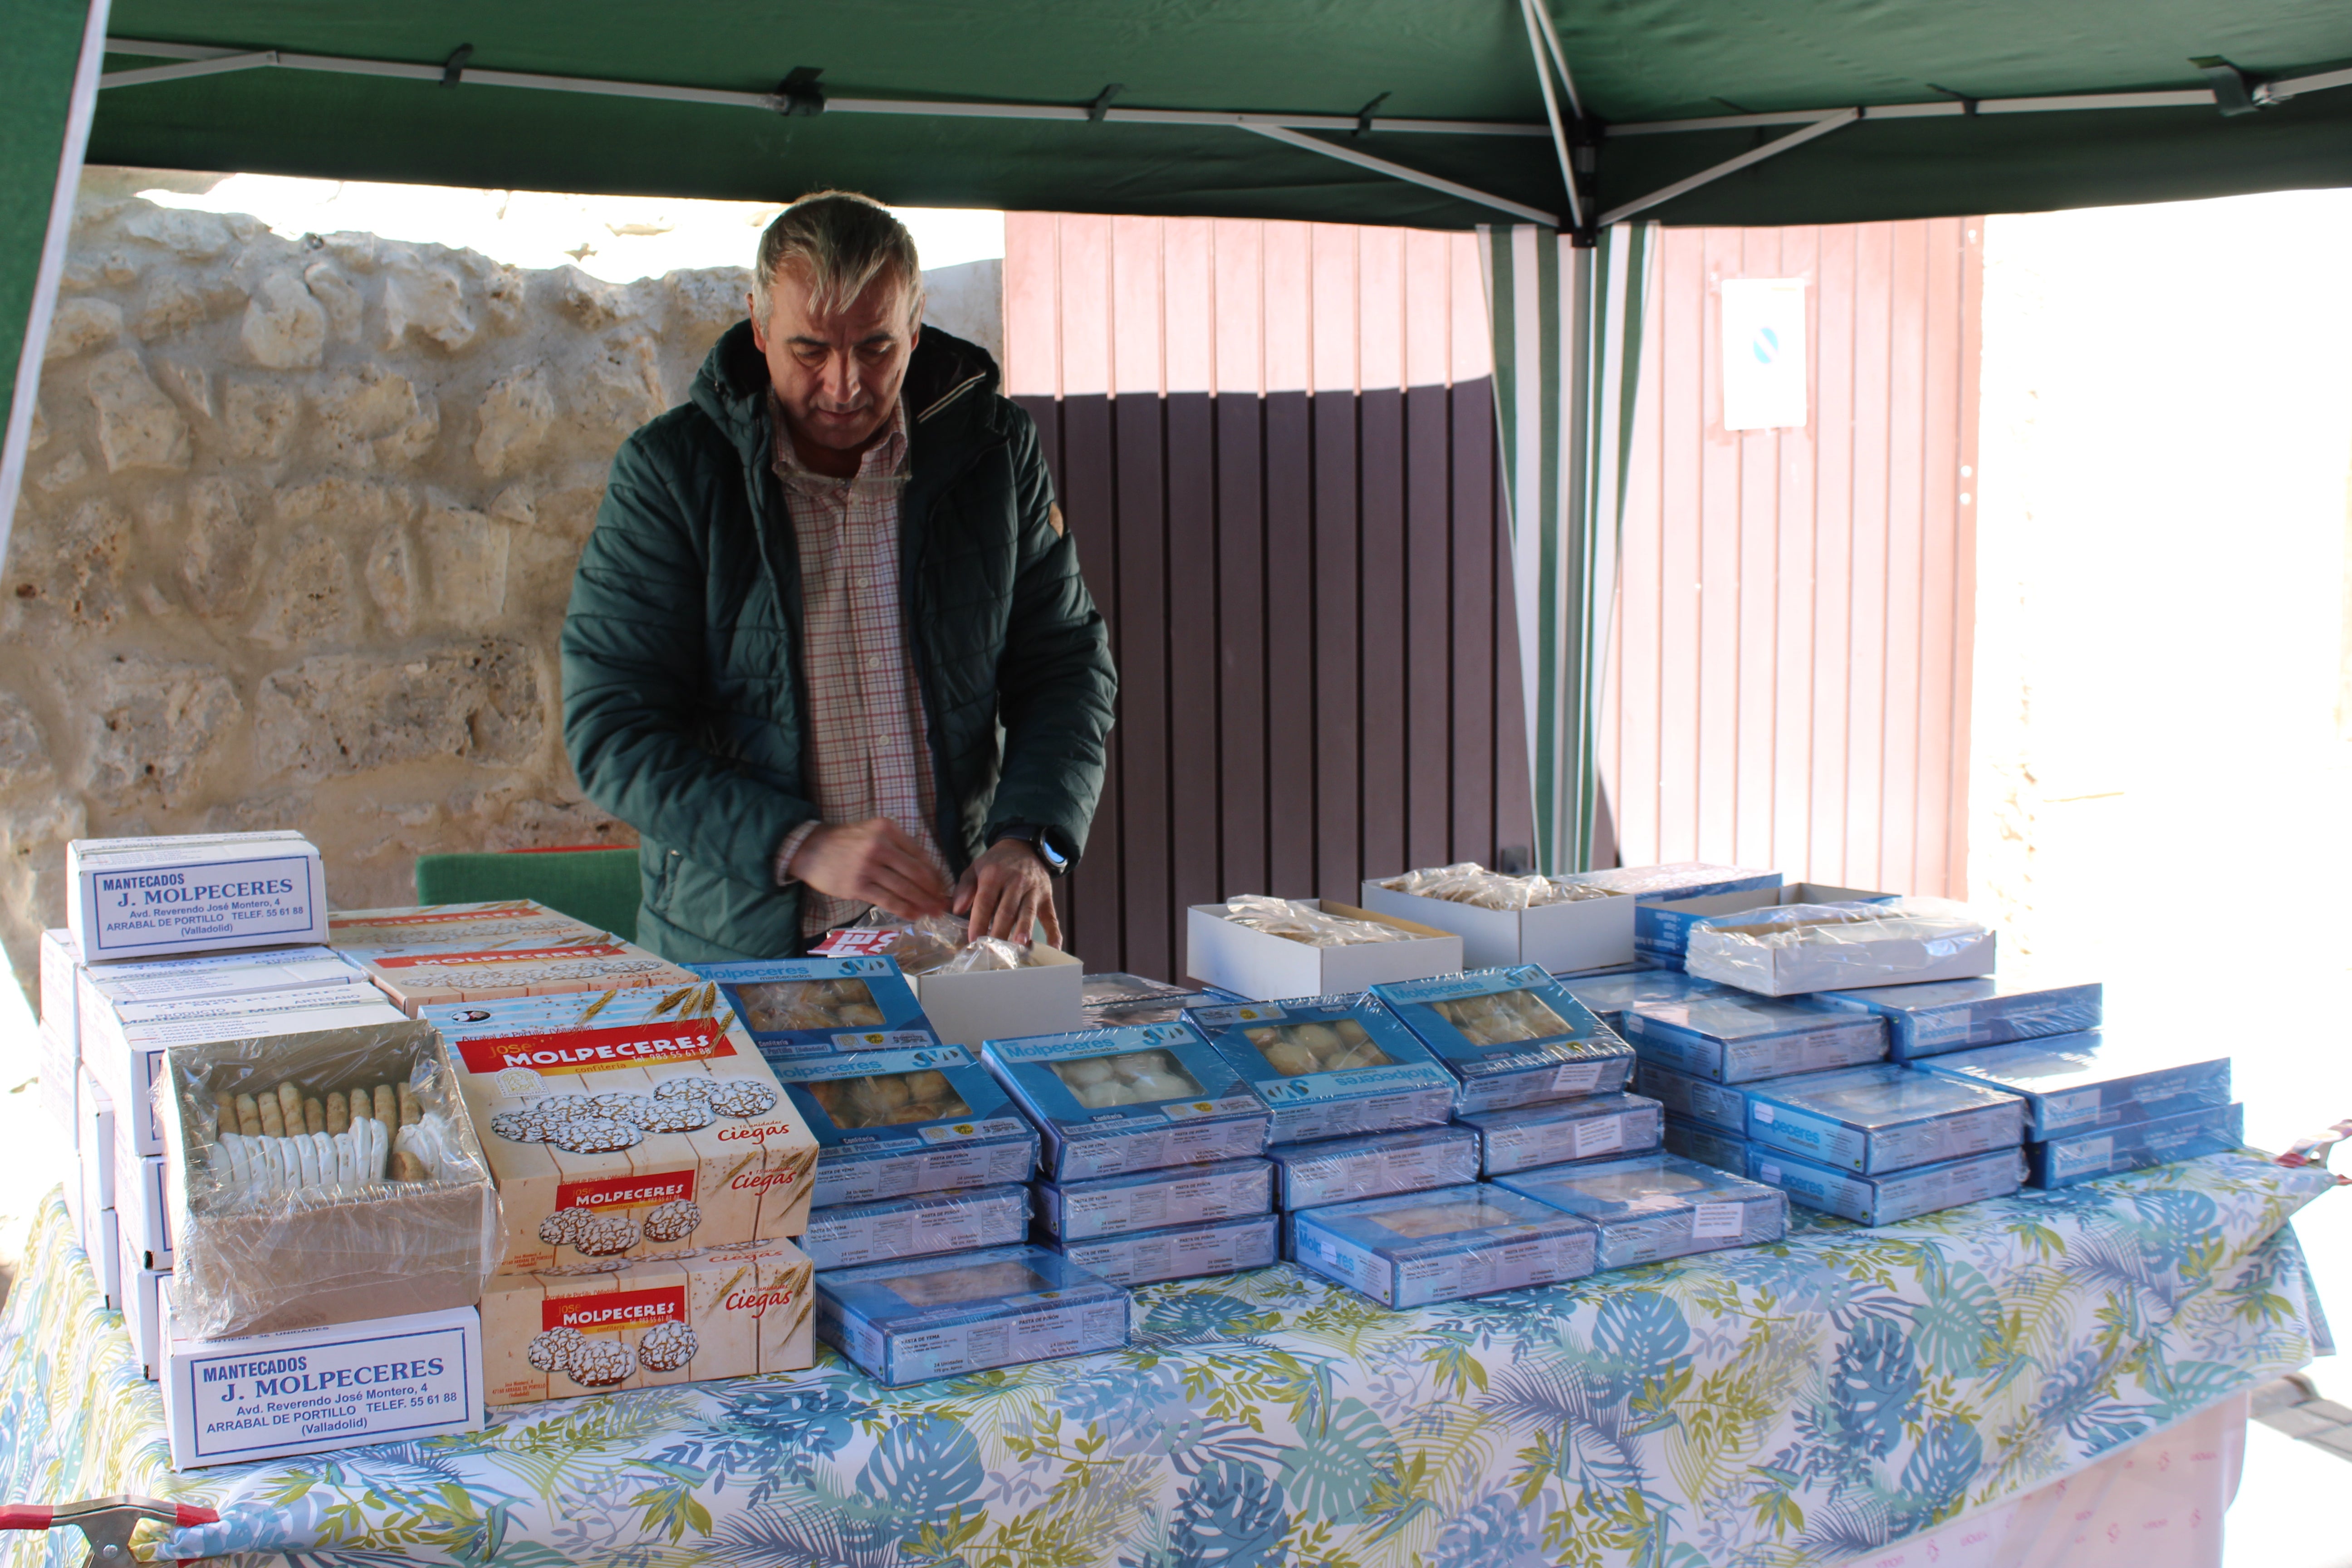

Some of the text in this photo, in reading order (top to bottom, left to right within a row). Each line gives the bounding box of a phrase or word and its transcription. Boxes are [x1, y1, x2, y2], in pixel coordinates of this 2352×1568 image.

[103, 873, 185, 891] MANTECADOS
[118, 878, 293, 907] J. MOLPECERES
[129, 909, 151, 918] Avd.
[154, 904, 204, 917] Reverendo
[206, 902, 229, 912] José
[231, 899, 272, 910] Montero,
[107, 906, 304, 931] ARRABAL DE PORTILLO TELEF. 55 61 88
[350, 911, 522, 928] MOLPECERES
[181, 923, 233, 937] (Valladolid)
[414, 948, 603, 966] MOLPECERES
[697, 965, 809, 980] Molpeceres
[1391, 980, 1484, 1000] Molpeceres
[122, 1000, 360, 1025] Mantecados Molpeceres
[155, 994, 360, 1019] PRODUCTO ARTESANO
[462, 1033, 496, 1042] Arrabal
[512, 1029, 545, 1038] Portillo
[549, 1025, 593, 1035] (Valladolid)
[503, 1034, 711, 1068] MOLPECERES
[767, 1046, 793, 1054] Portillo
[1004, 1038, 1115, 1058] Molpeceres
[1069, 1046, 1120, 1057] mantecados
[575, 1048, 712, 1074] confitería Tel. 983 55 61 88
[831, 1068, 887, 1078] mantecados
[1335, 1068, 1434, 1087] Molpeceres
[749, 1120, 782, 1128] unidades
[1067, 1124, 1092, 1133] Arrabal
[1105, 1119, 1130, 1128] Portillo
[1093, 1113, 1123, 1122] Confitería
[718, 1124, 789, 1145] Ciegas
[843, 1135, 876, 1145] Confitería
[854, 1142, 882, 1152] Portillo
[731, 1171, 797, 1196] Ciegas
[572, 1187, 594, 1199] jose
[576, 1184, 684, 1206] MOLPECERES
[607, 1203, 634, 1211] confitería
[709, 1251, 784, 1263] Ciegas
[558, 1302, 582, 1316] jose
[726, 1289, 793, 1318] Ciegas
[563, 1302, 675, 1326] MOLPECERES
[1043, 1314, 1059, 1322] PIÑÓN
[276, 1326, 329, 1337] UNIDADES
[597, 1324, 625, 1333] confitería
[203, 1356, 307, 1382] MANTECADOS
[220, 1357, 445, 1402] J. MOLPECERES
[236, 1383, 428, 1416] Avd. Reverendo José Montero, 4
[206, 1392, 458, 1434] ARRABAL DE PORTILLO TELEF. 55 61 88
[301, 1417, 368, 1436] (Valladolid)
